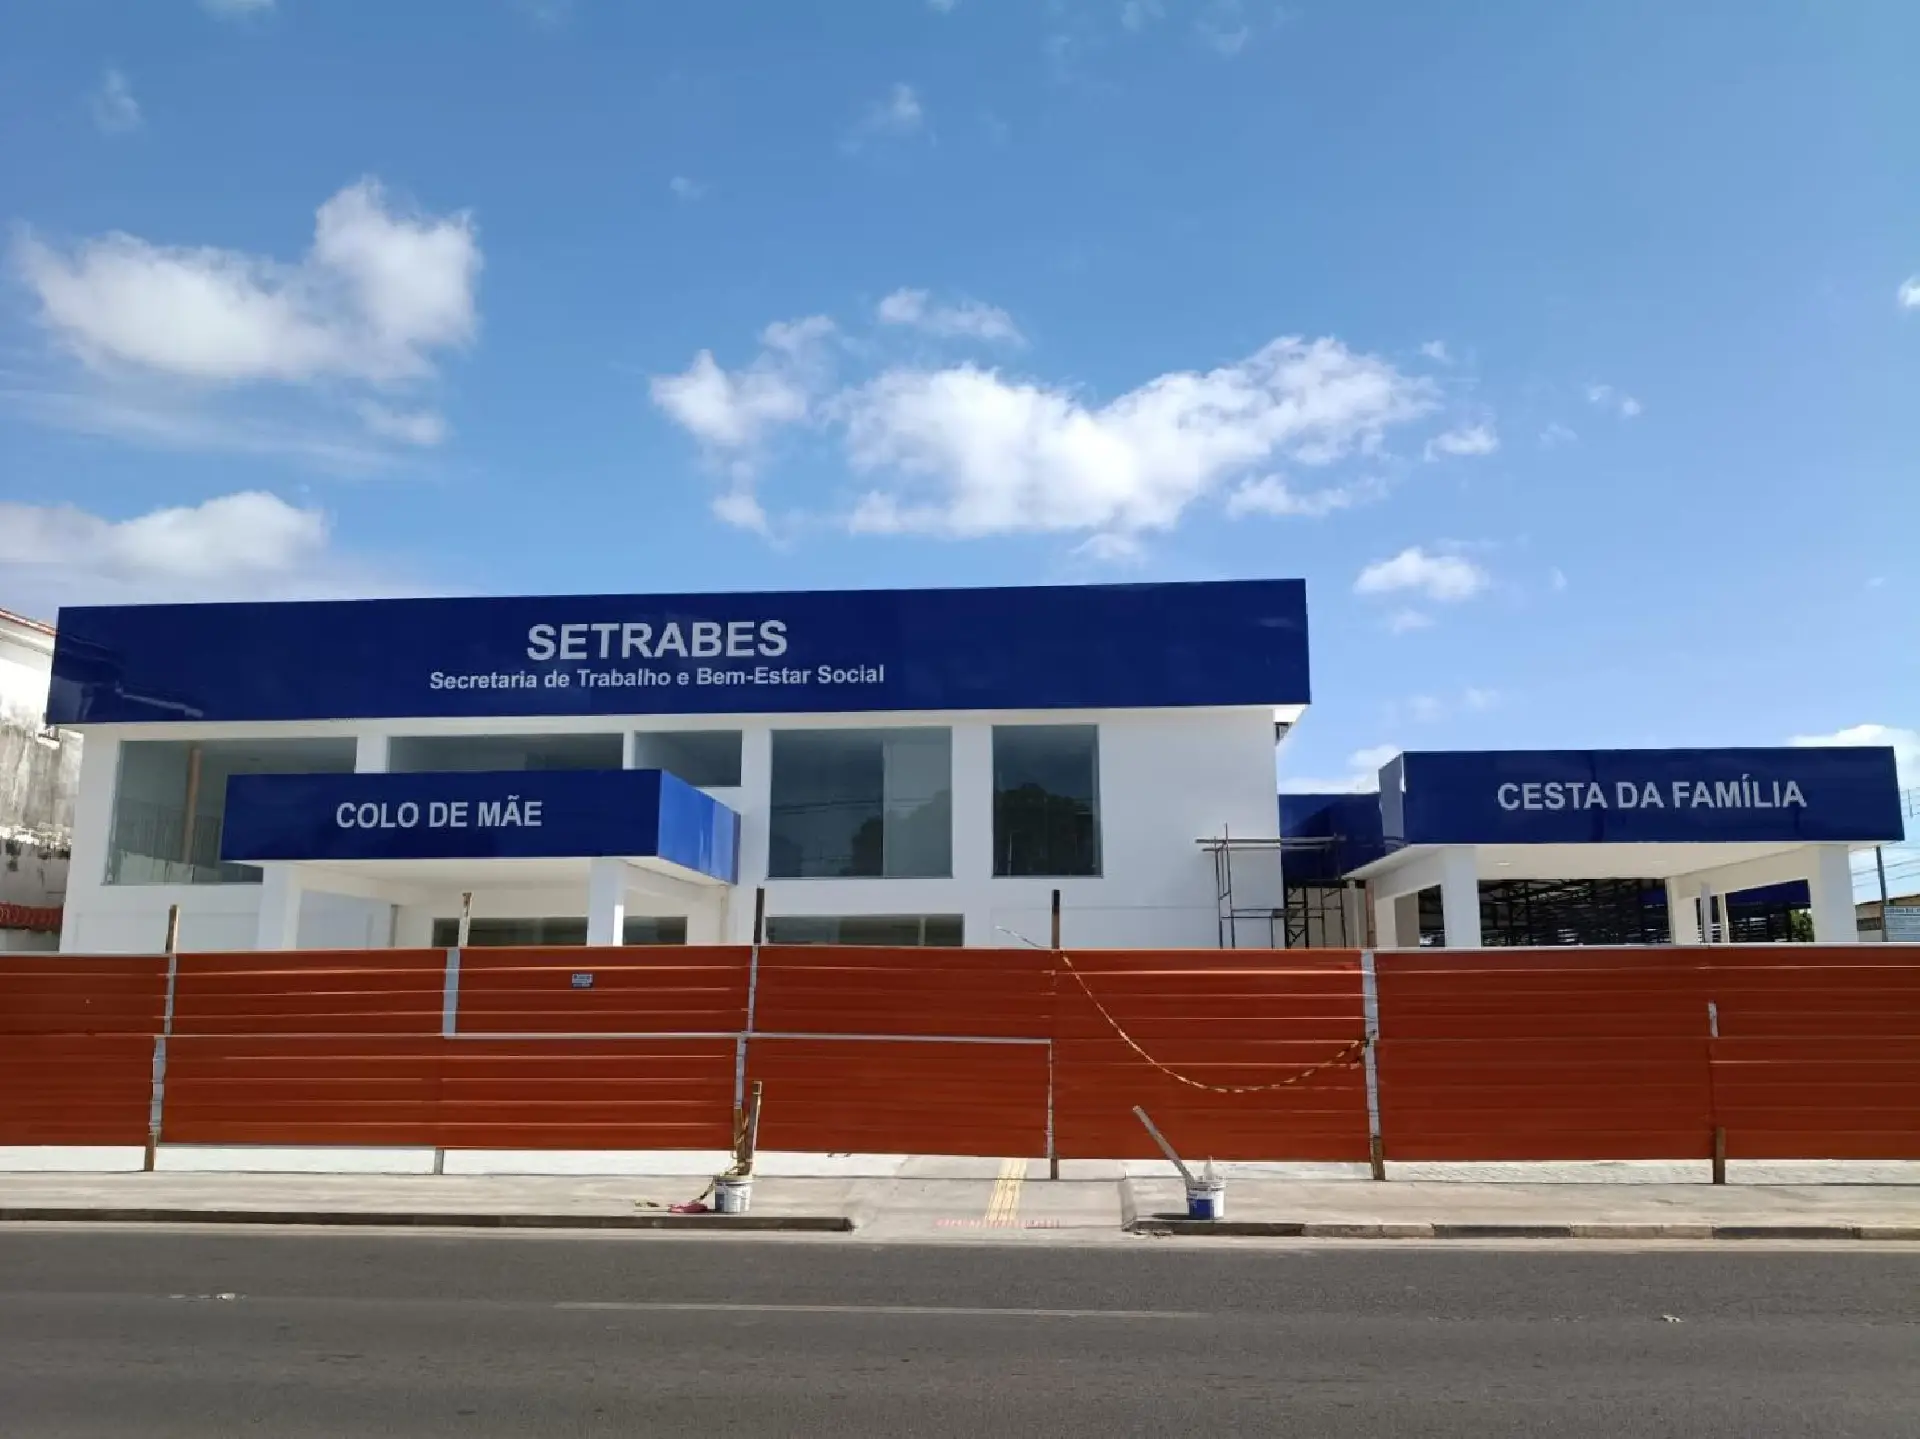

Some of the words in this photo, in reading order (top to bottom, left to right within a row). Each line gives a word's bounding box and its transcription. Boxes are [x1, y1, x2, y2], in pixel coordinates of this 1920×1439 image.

[527, 620, 787, 660] SETRABES
[430, 671, 537, 690] Secretaria
[544, 669, 570, 688] de
[577, 668, 671, 688] Trabalho
[677, 671, 690, 685] e
[696, 667, 812, 686] Bem-Estar
[817, 664, 885, 684] Social
[1497, 782, 1608, 811] CESTA
[1617, 781, 1665, 809] DA
[1672, 773, 1807, 808] FAMÍLIA
[336, 802, 419, 829] COLO
[429, 801, 469, 828] DE
[477, 794, 543, 827] MÃE
